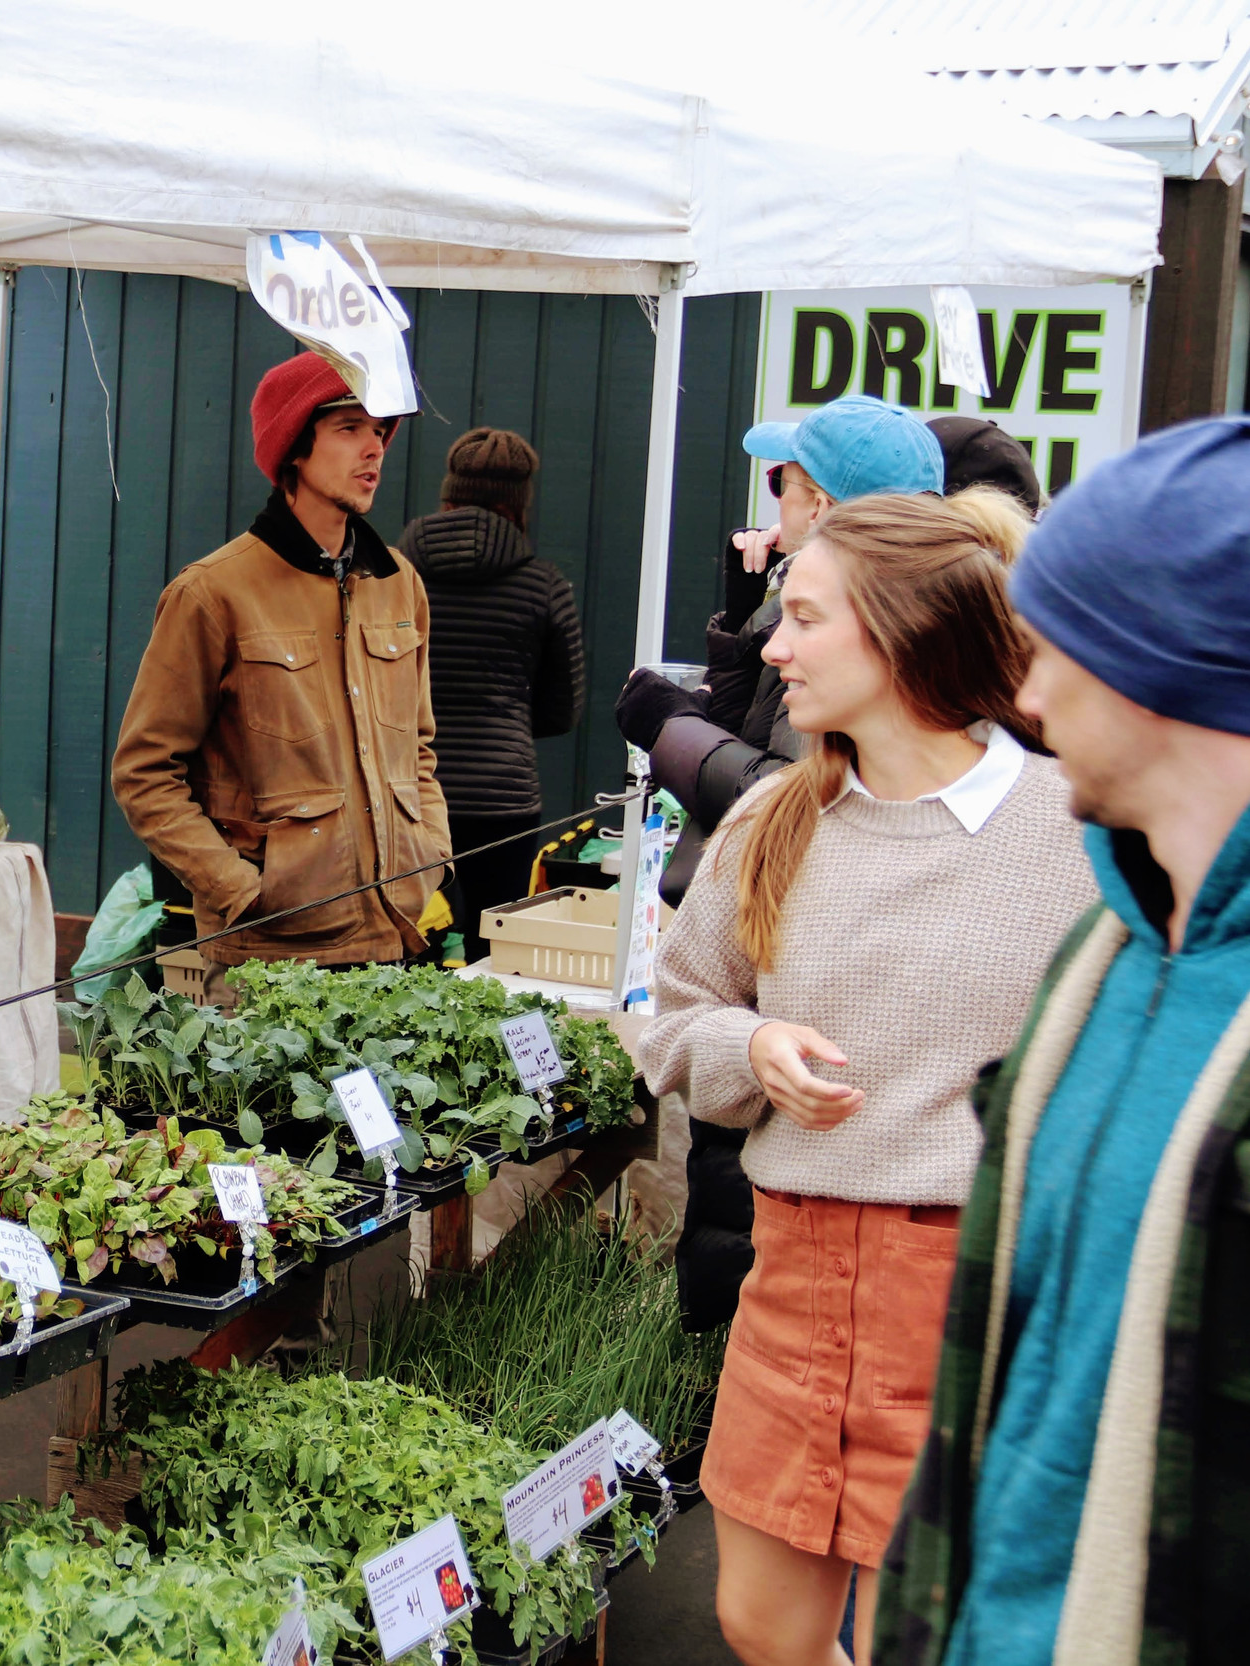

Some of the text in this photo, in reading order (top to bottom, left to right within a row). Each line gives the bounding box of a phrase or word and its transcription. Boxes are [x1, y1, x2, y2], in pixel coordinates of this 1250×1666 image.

[787, 307, 1107, 415] DRVE
[504, 1025, 525, 1038] KALE
[26, 1263, 40, 1281] $4
[506, 1467, 557, 1512] MOUNTAIN
[558, 1430, 605, 1471] PRINCESS
[552, 1497, 569, 1527] $4
[367, 1555, 405, 1584] GLACIER
[406, 1586, 424, 1618] $4
[267, 1636, 282, 1666] OLD
